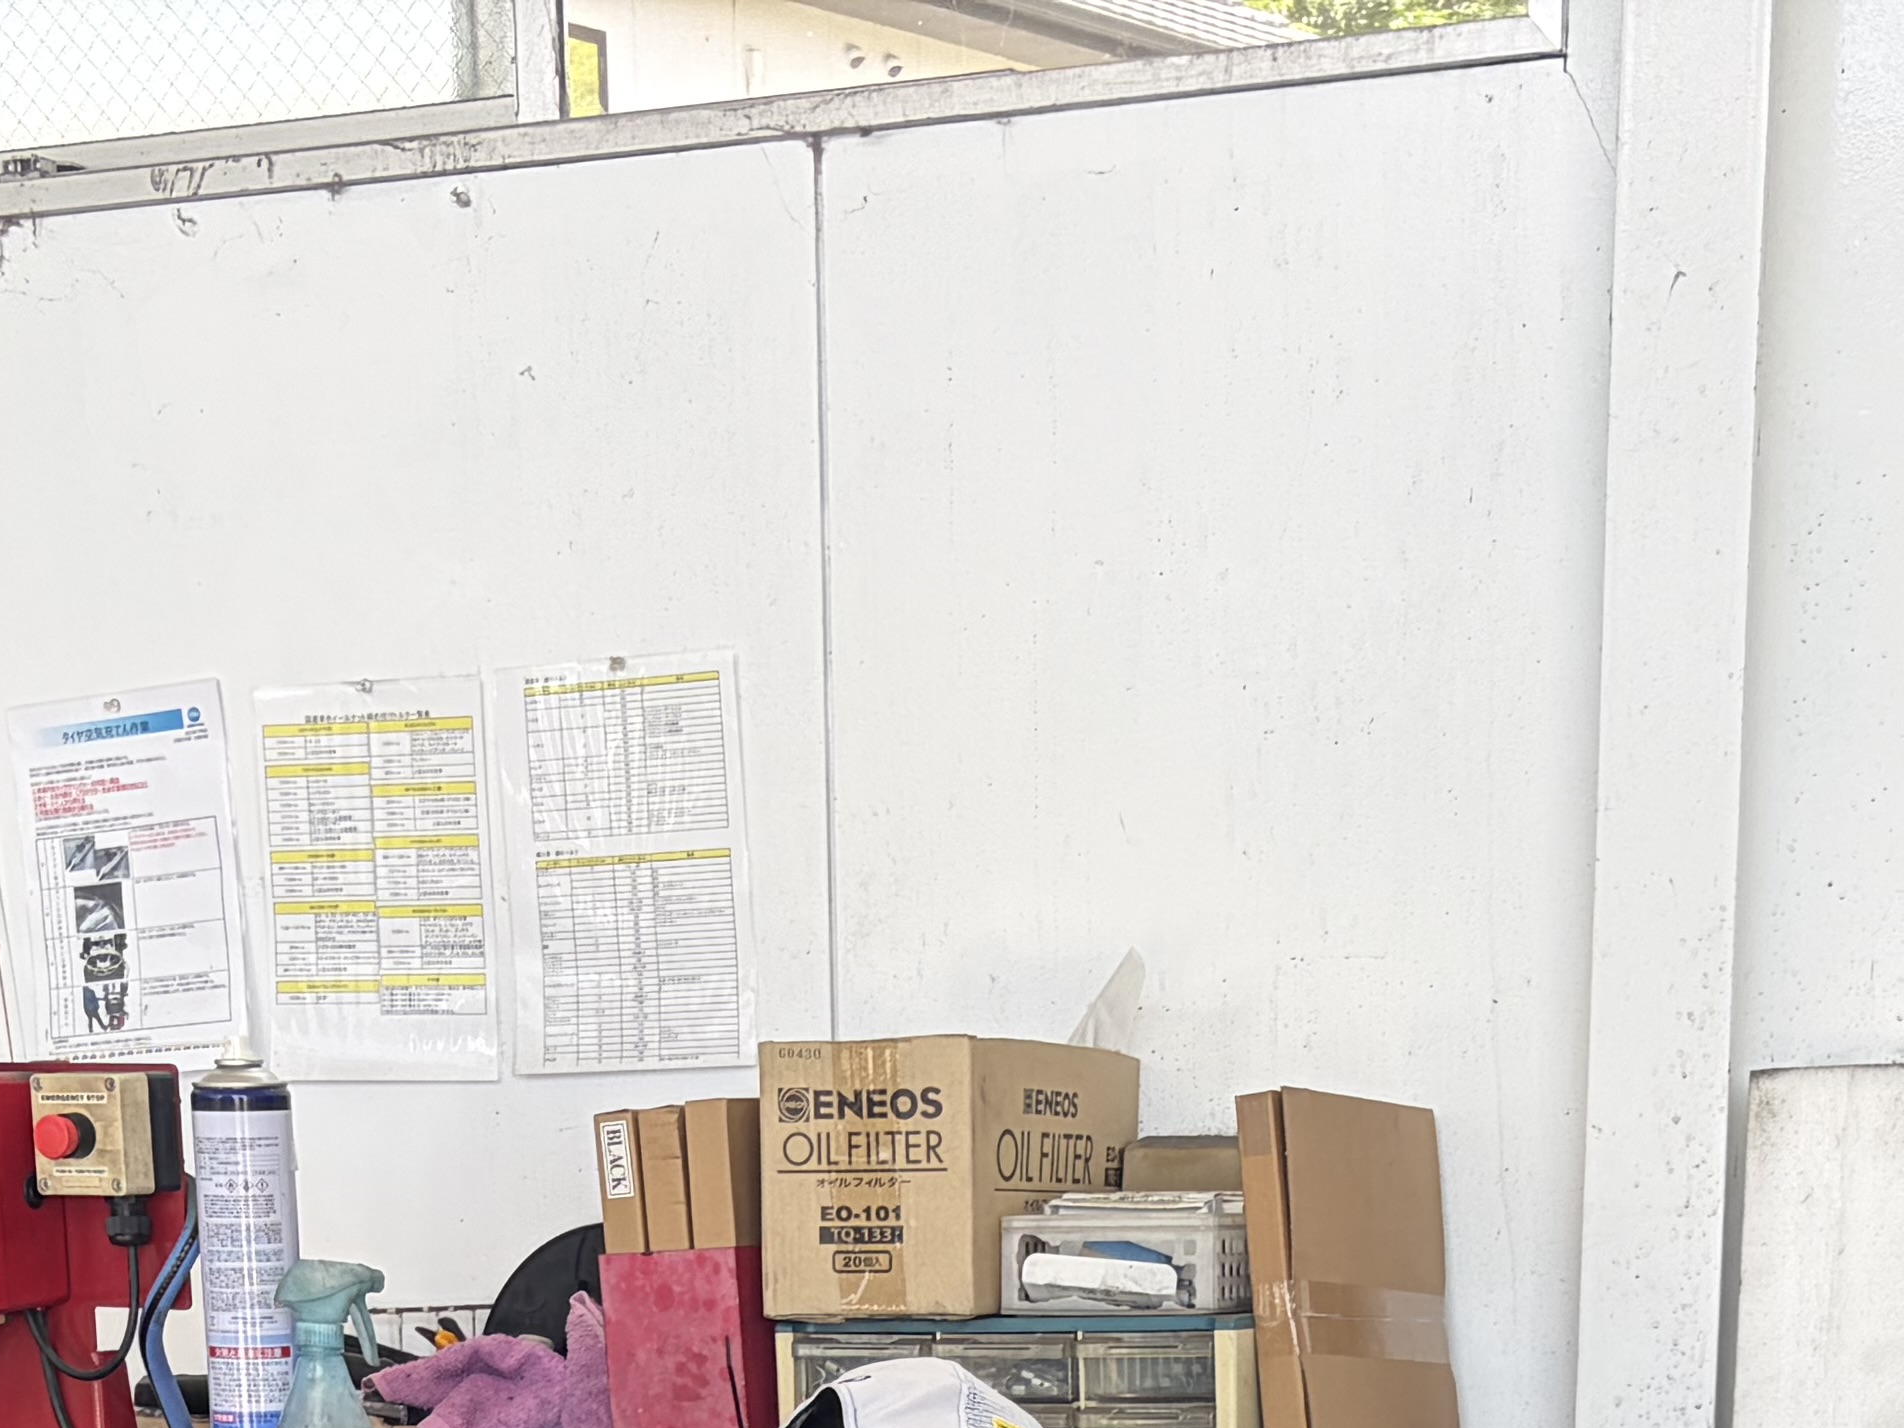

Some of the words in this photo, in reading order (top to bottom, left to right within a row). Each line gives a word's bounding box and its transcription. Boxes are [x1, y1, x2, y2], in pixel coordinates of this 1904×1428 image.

[812, 1086, 944, 1120] ENEOS
[1034, 1088, 1080, 1119] ENEOS
[605, 1127, 629, 1193] BLACK
[782, 1130, 840, 1167] OIL
[847, 1129, 944, 1166] FILTER
[996, 1128, 1034, 1184] OIL
[1035, 1132, 1095, 1187] FILTER
[815, 1175, 912, 1189] オイルフィルター
[820, 1205, 902, 1222] EO-101
[842, 1255, 883, 1269] 20個入
